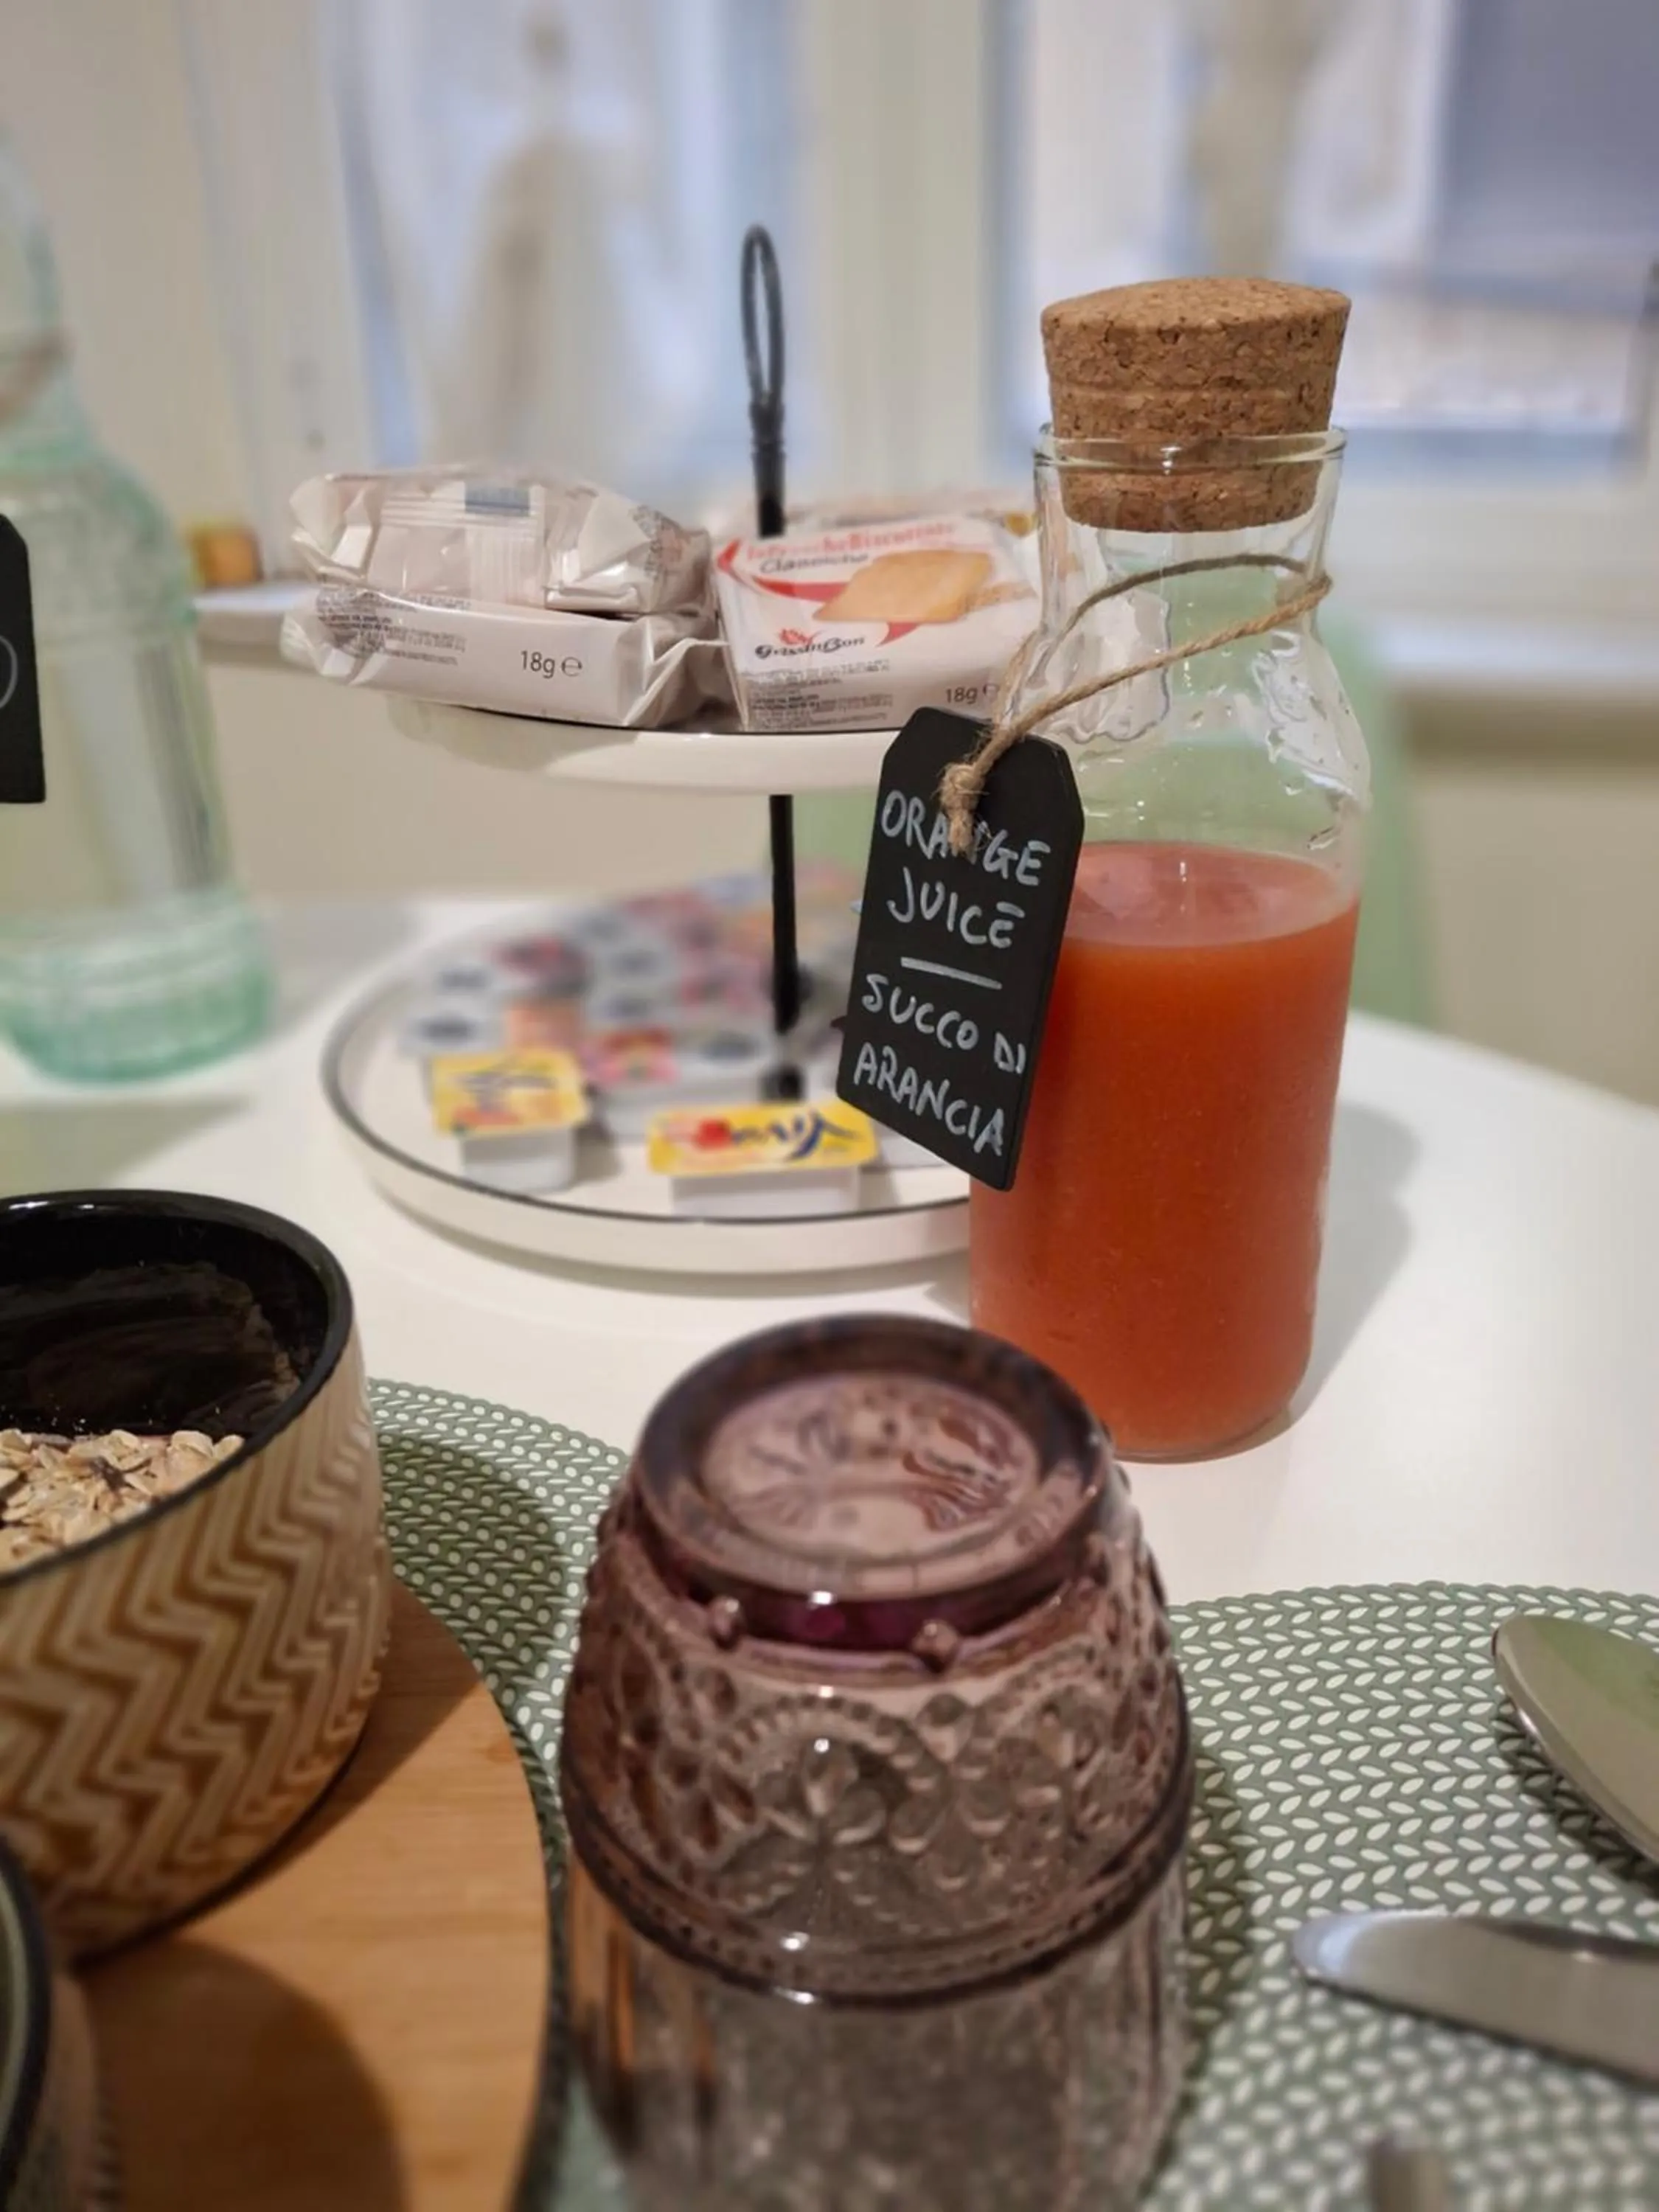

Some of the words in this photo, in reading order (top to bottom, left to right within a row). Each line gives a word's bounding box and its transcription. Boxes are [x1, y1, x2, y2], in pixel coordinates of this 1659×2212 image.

[521, 650, 555, 679] 18g
[945, 686, 978, 704] 18g
[886, 866, 1026, 949] JUICE
[862, 973, 979, 1051] SUCCO
[994, 1032, 1026, 1074] DI
[853, 1042, 1004, 1157] ARANCIA
